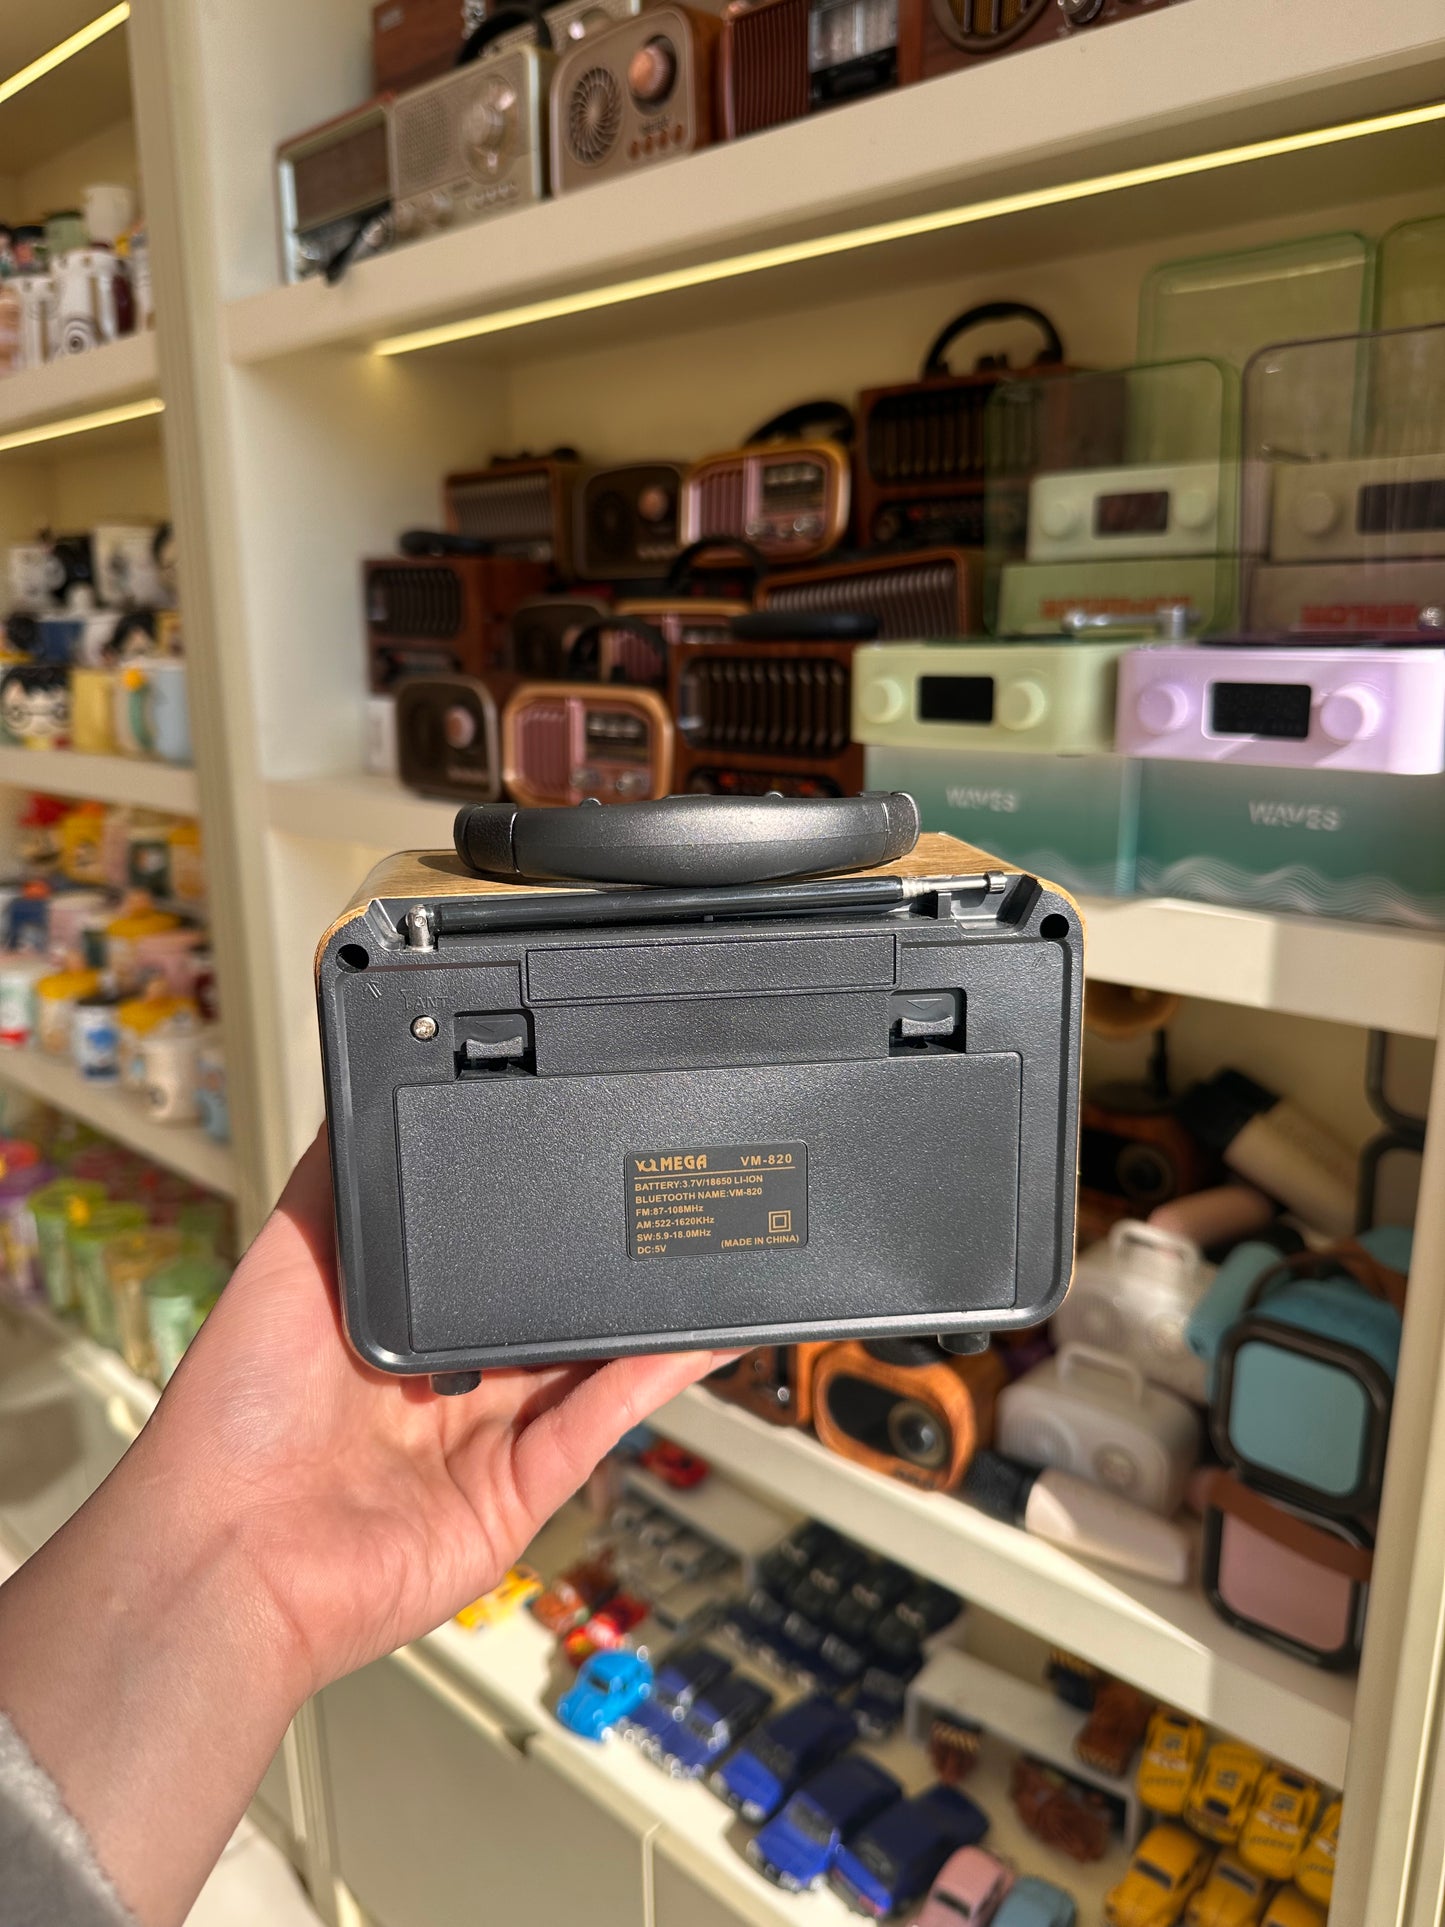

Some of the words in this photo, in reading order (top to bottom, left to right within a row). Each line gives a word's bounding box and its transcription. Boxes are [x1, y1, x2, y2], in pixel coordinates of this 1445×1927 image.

[1248, 799, 1344, 831] WAVES
[740, 1153, 793, 1167] VM-820
[634, 1176, 732, 1192] BATTERY:3.7V/18650
[733, 1175, 763, 1185] LI-ION
[635, 1193, 696, 1204] BLUETOOTH
[697, 1187, 763, 1199] NAME:VM-820
[635, 1204, 704, 1217] FM:87-108MHz
[636, 1216, 715, 1230] AM:522-1620KHz
[636, 1229, 711, 1242] SW:5.9-18.0MHz
[721, 1237, 752, 1249] (MADE
[766, 1234, 800, 1244] CHINA)
[637, 1245, 667, 1255] DC:5V
